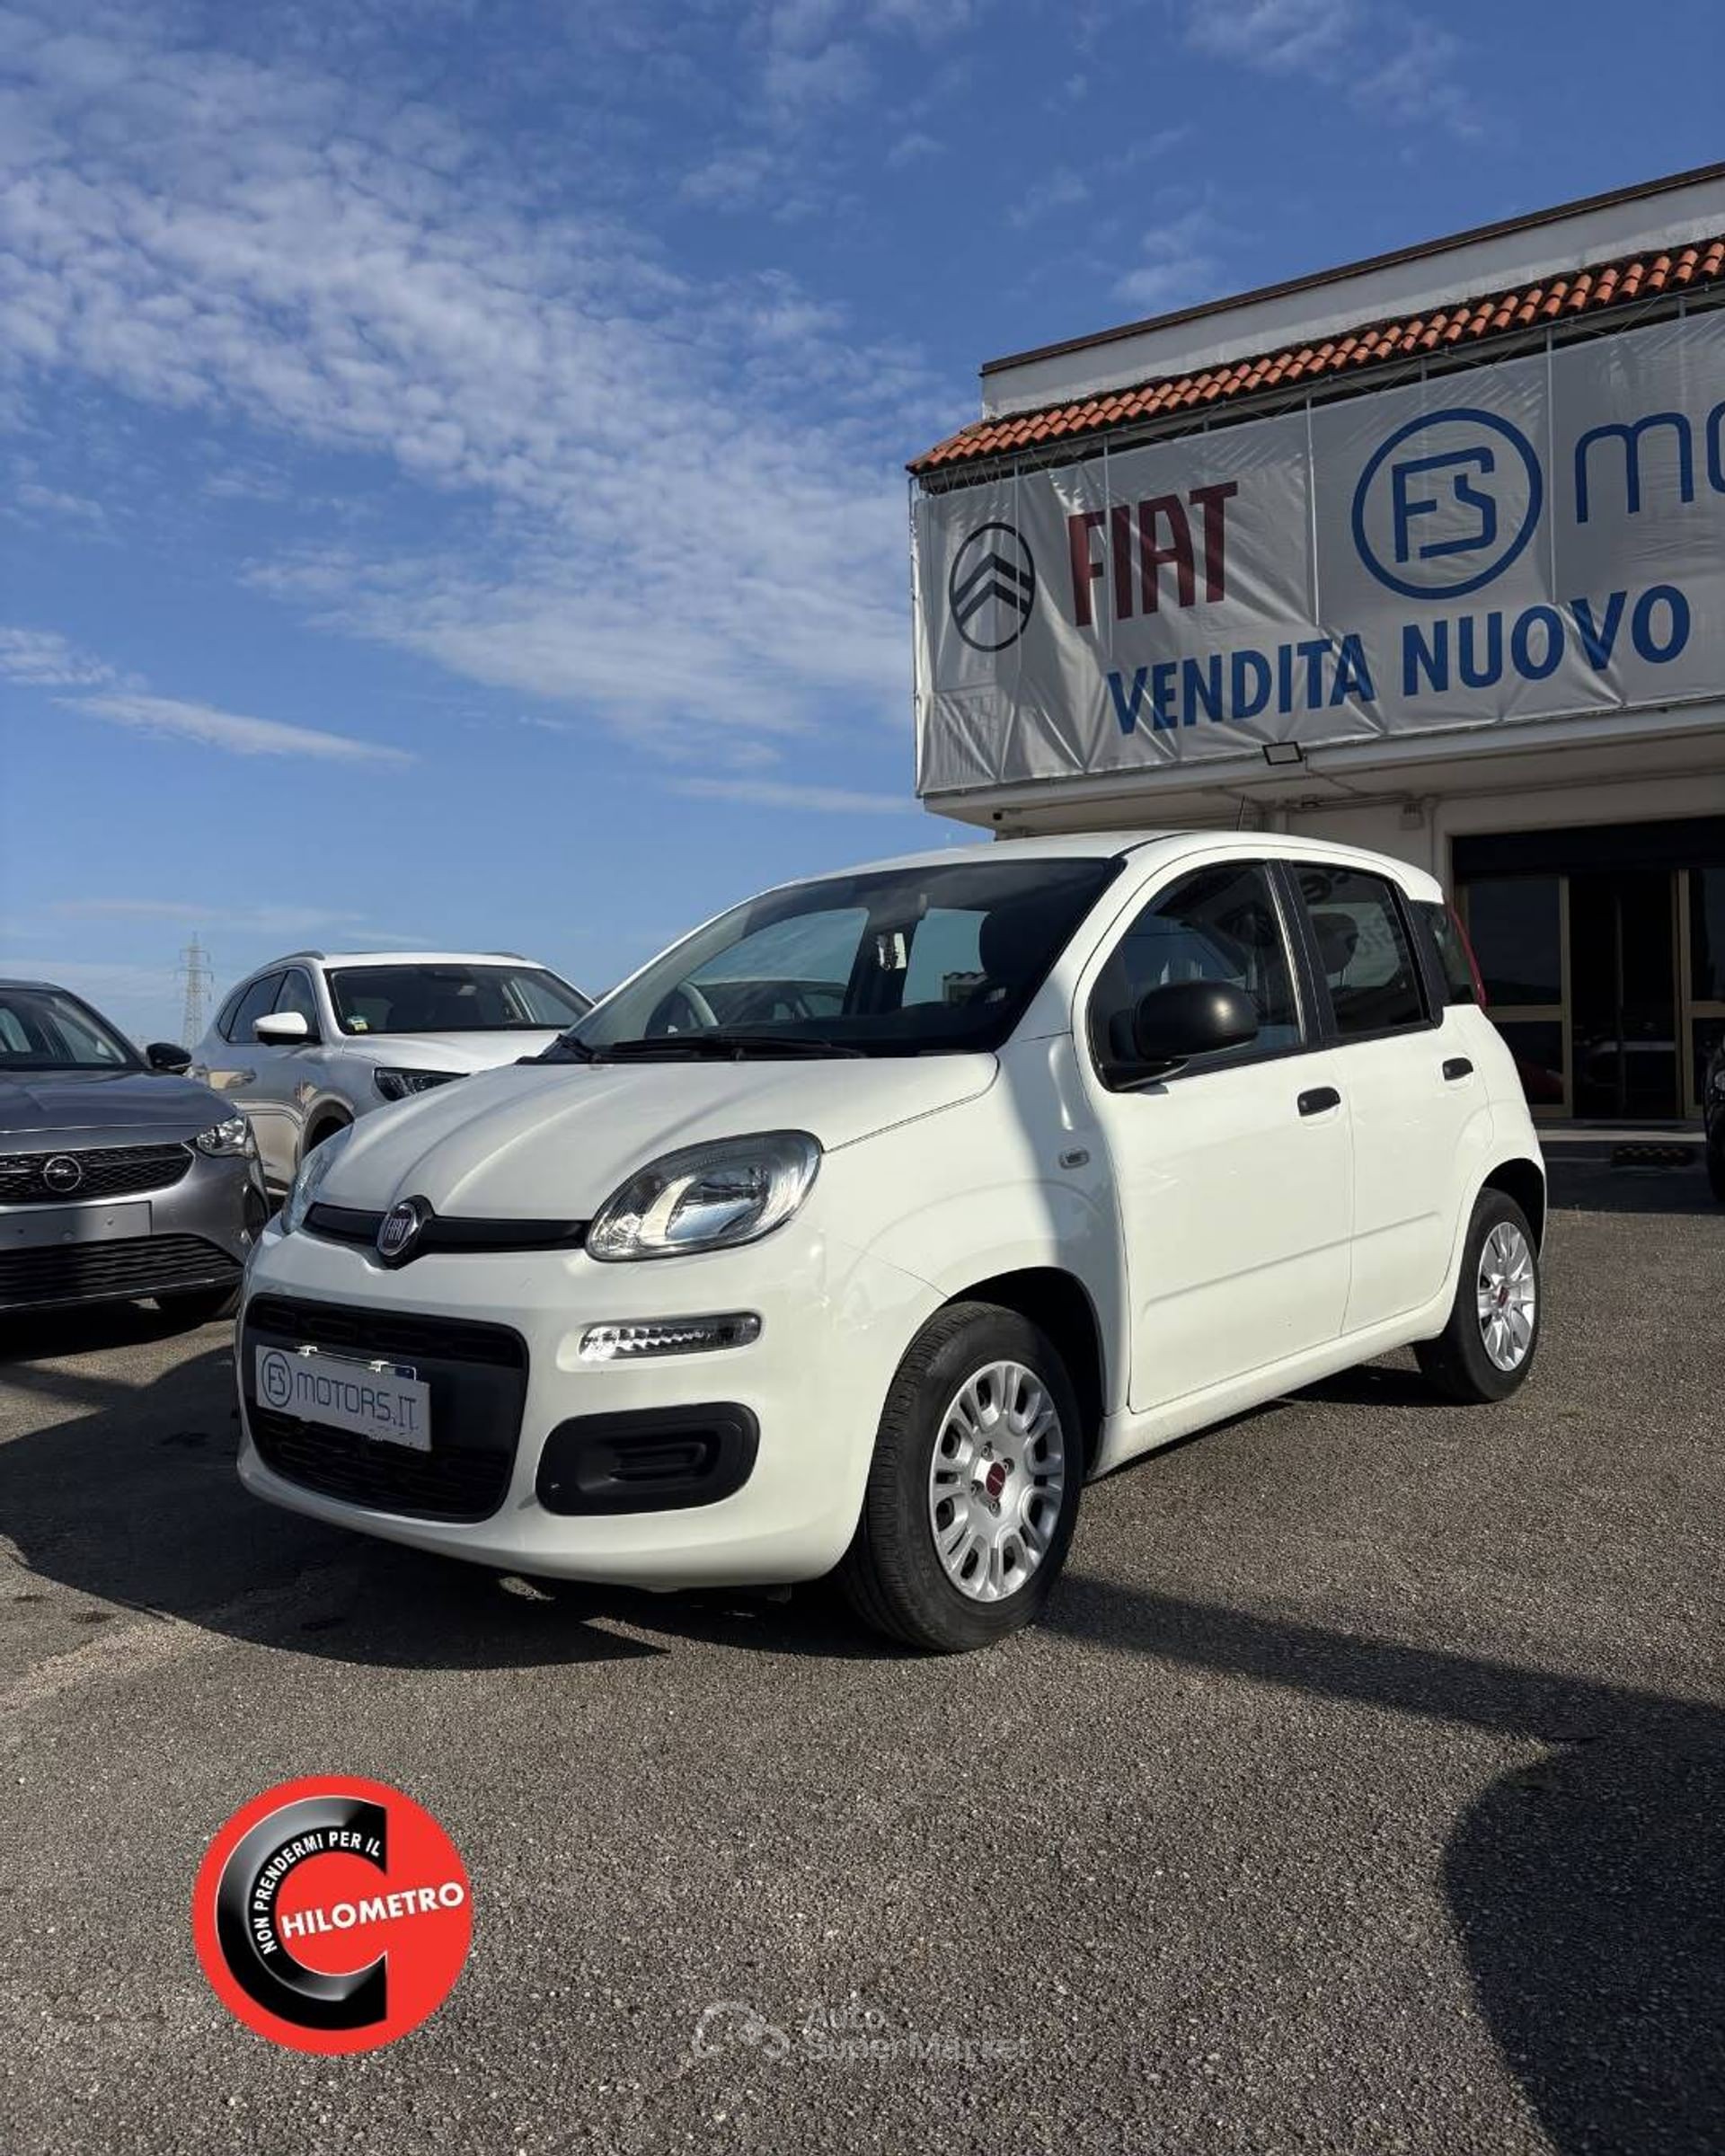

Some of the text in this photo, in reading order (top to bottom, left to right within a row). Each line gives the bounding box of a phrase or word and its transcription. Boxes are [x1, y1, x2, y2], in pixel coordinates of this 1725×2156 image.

[1068, 481, 1238, 627] FIAT
[1107, 585, 1691, 735] VENDITA NUOVO
[385, 1218, 410, 1241] FIAT
